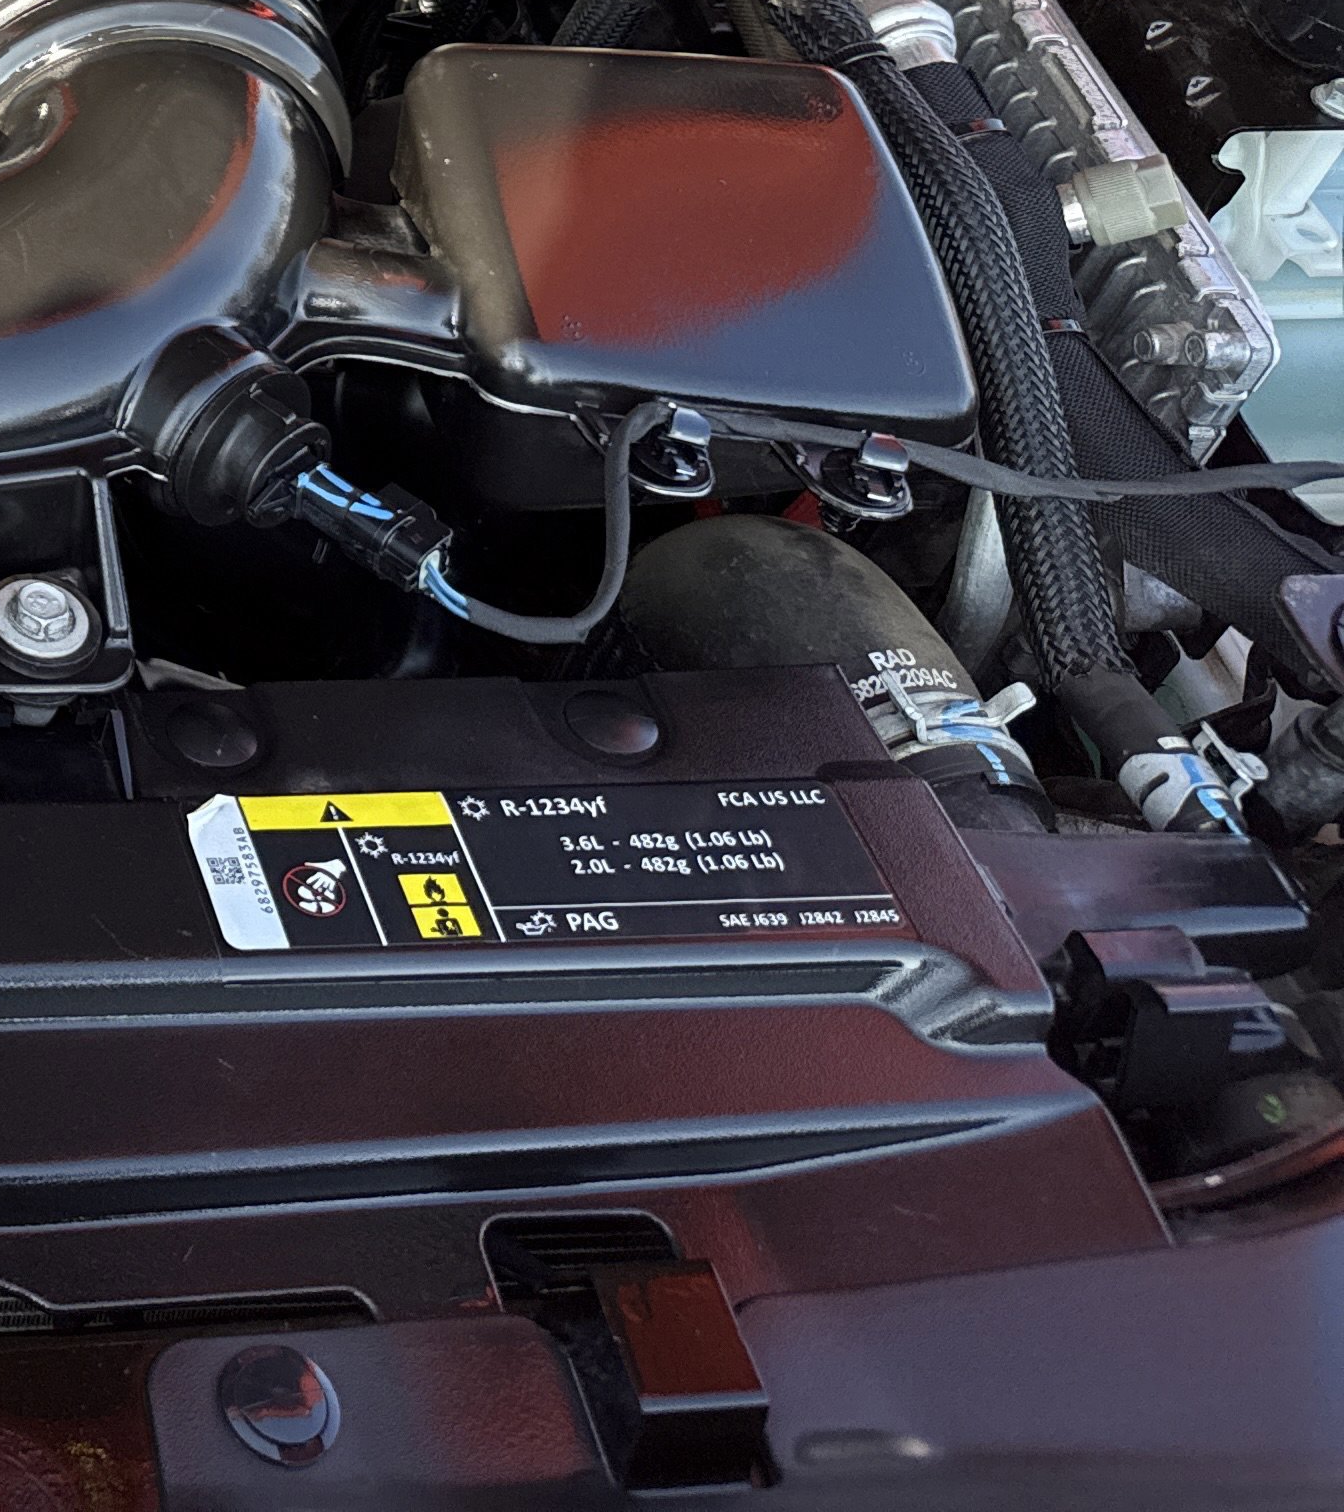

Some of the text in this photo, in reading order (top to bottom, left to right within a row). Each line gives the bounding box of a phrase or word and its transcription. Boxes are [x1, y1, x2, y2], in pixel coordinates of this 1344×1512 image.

[868, 648, 916, 671] RAD
[500, 795, 607, 818] R-1234yf
[717, 789, 826, 807] FCA US LLC
[560, 835, 605, 852] 3.6L
[629, 833, 680, 851] 482g
[685, 831, 737, 851] (1.06
[738, 829, 772, 848] Lb)
[391, 850, 461, 866] R-1234yf
[571, 858, 616, 875] 2.0L
[640, 856, 691, 875] 482g
[696, 854, 749, 874] (1.06
[750, 852, 785, 872] Lb)
[233, 826, 274, 915] 68297583AB
[565, 911, 619, 932] PAG
[719, 909, 900, 928] SAE J639 J2842 J2845
